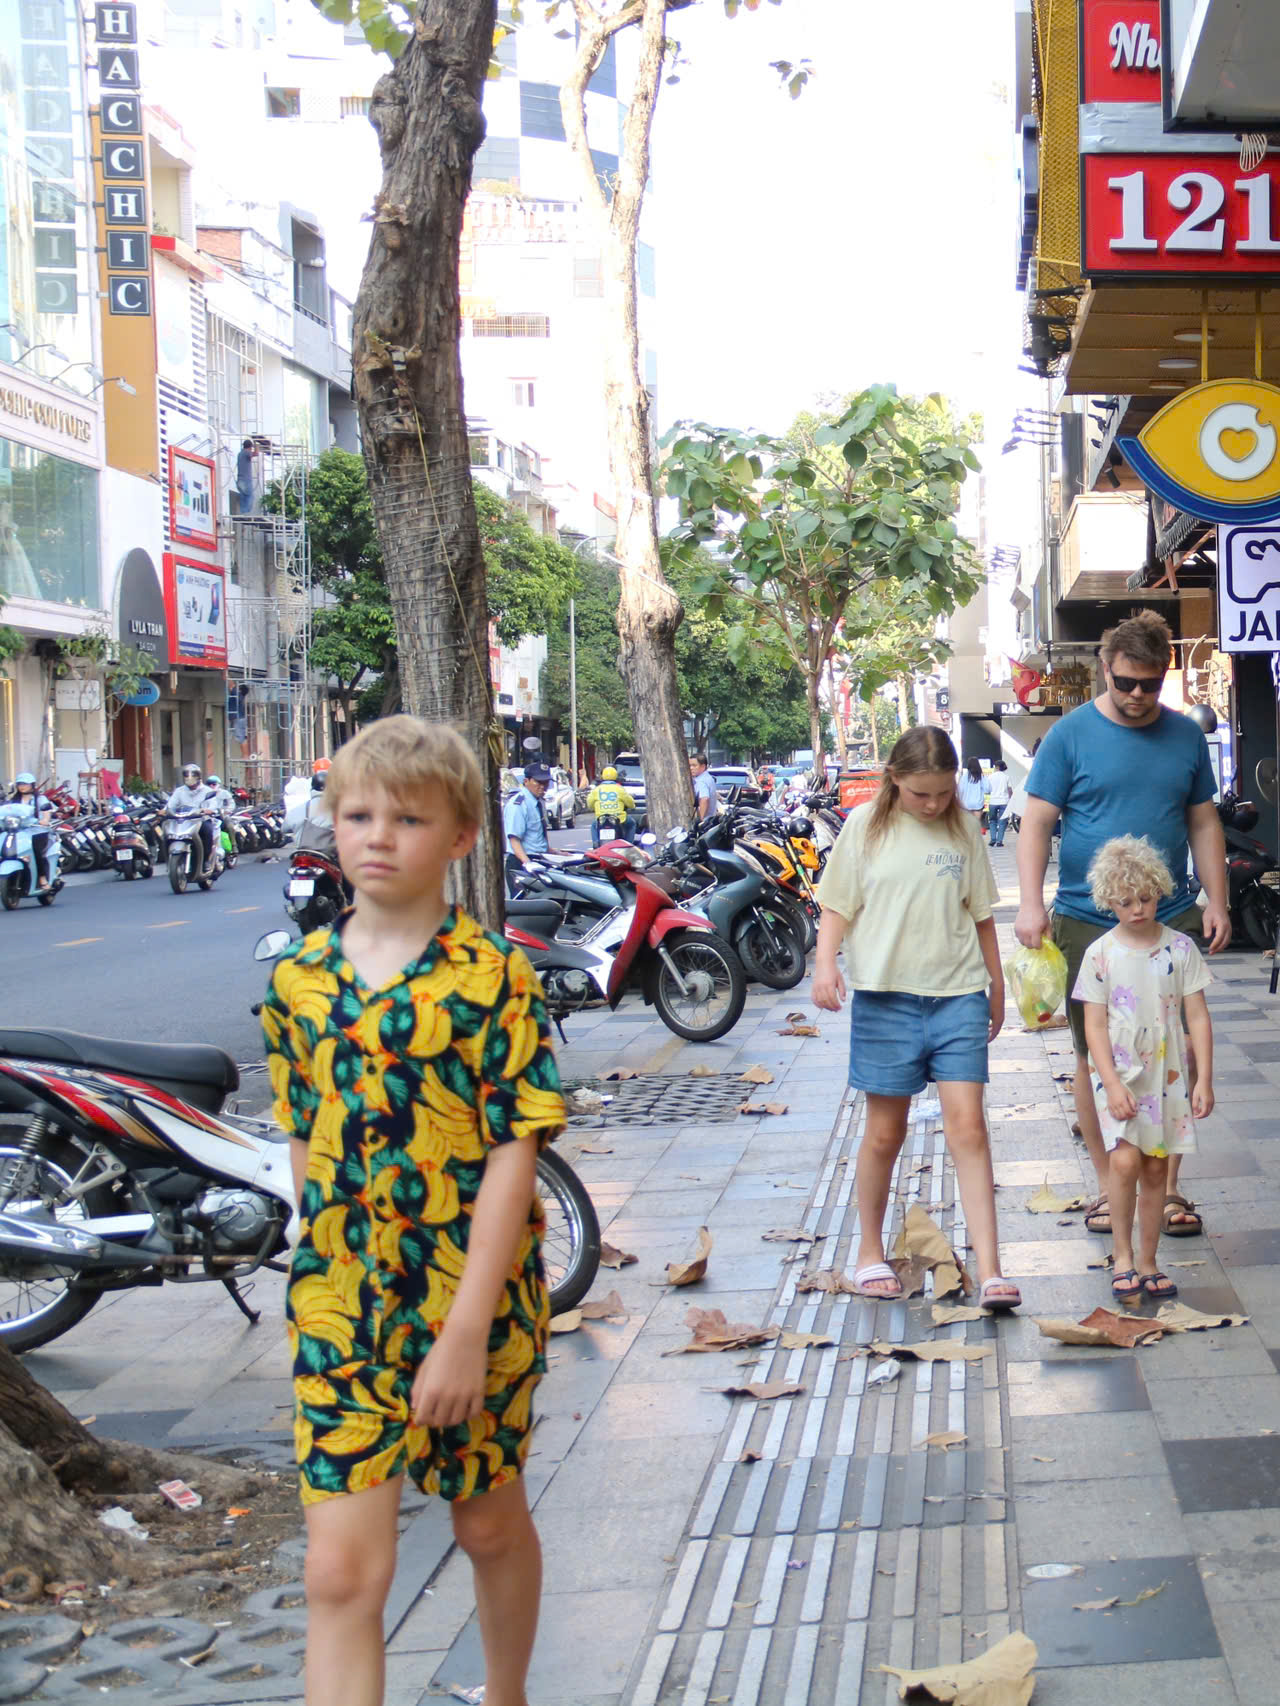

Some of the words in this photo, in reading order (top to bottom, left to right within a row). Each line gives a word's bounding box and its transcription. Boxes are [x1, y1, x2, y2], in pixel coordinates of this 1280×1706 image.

[1109, 22, 1161, 70] Nh
[101, 9, 143, 308] HACCHIC
[599, 788, 617, 801] be
